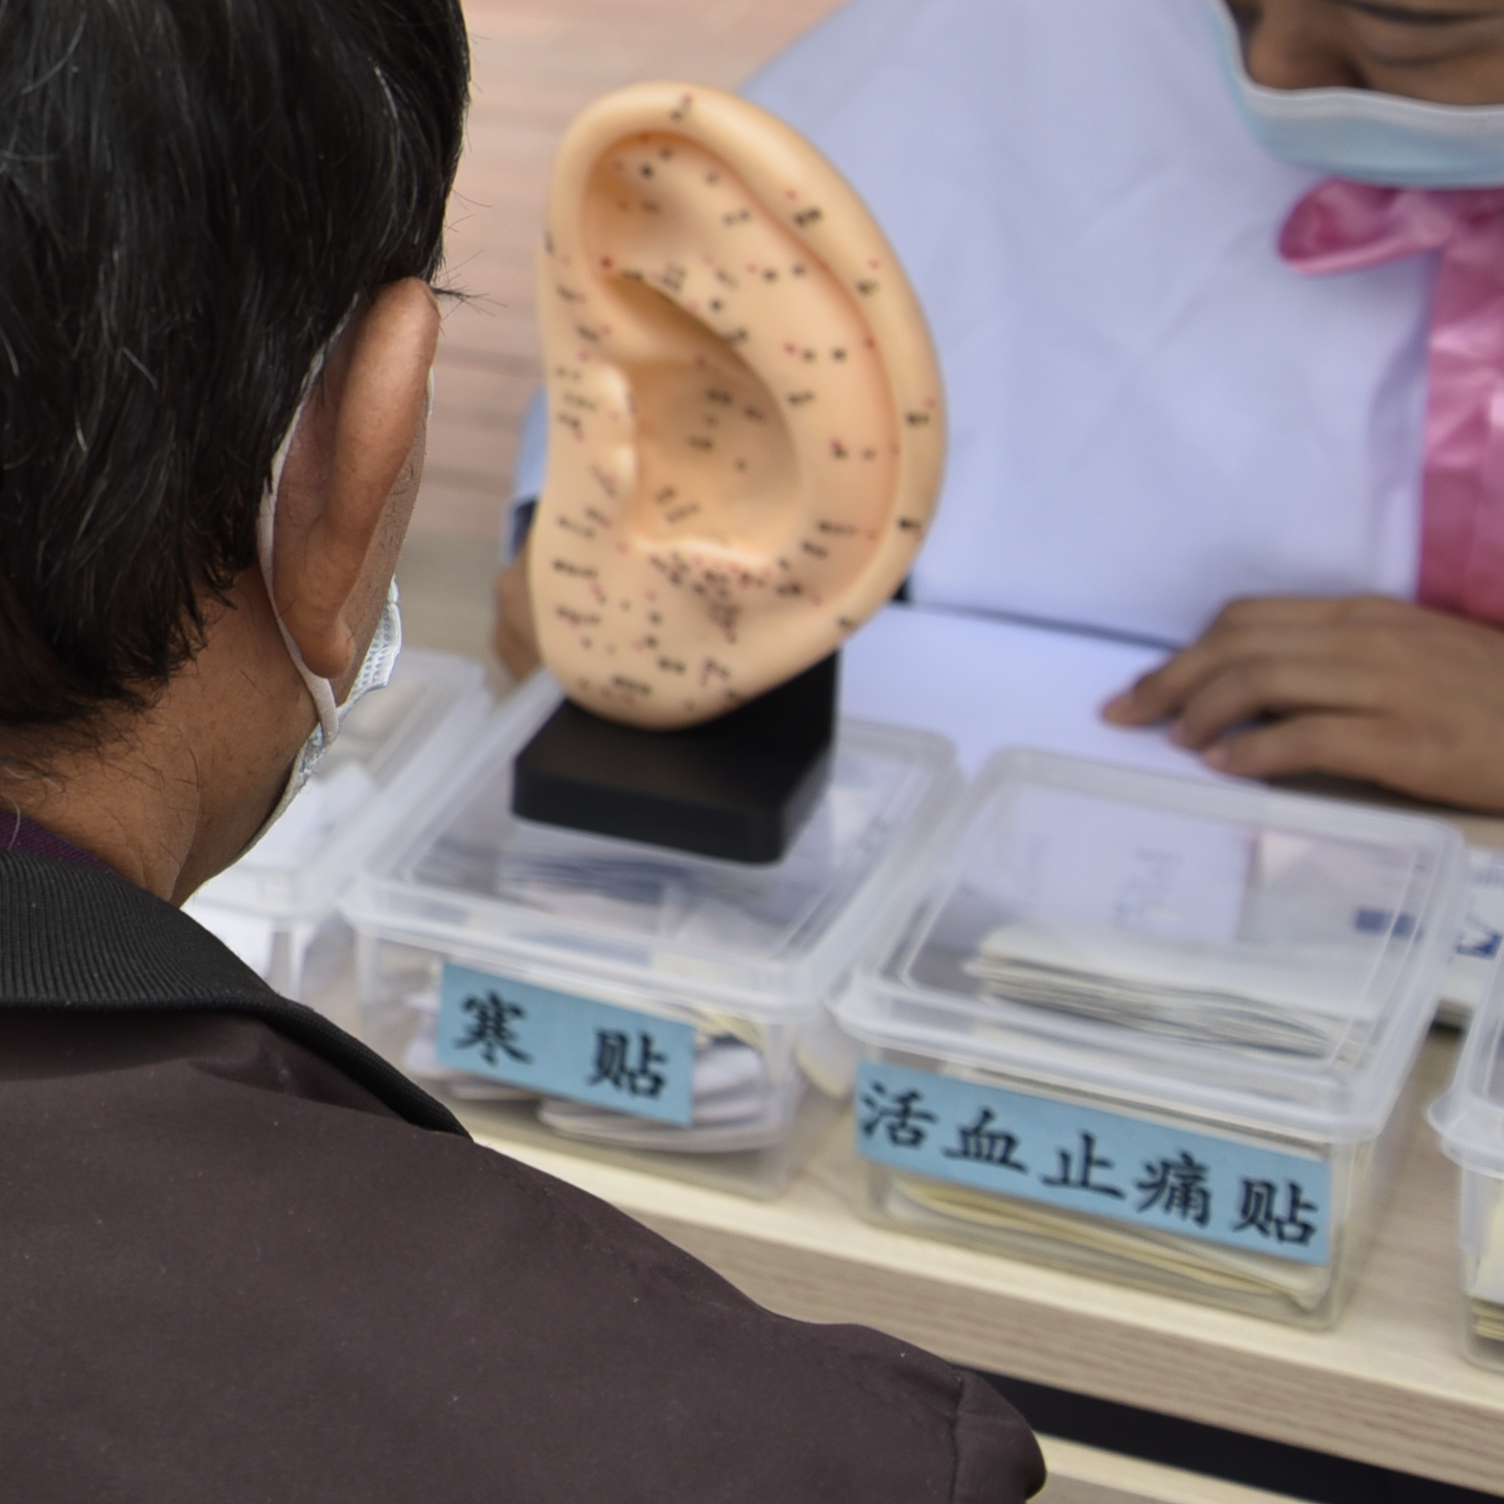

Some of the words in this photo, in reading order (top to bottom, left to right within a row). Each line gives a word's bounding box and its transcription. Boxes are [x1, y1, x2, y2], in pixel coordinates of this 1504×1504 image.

[861, 1081, 1320, 1248] 活血止痛贴
